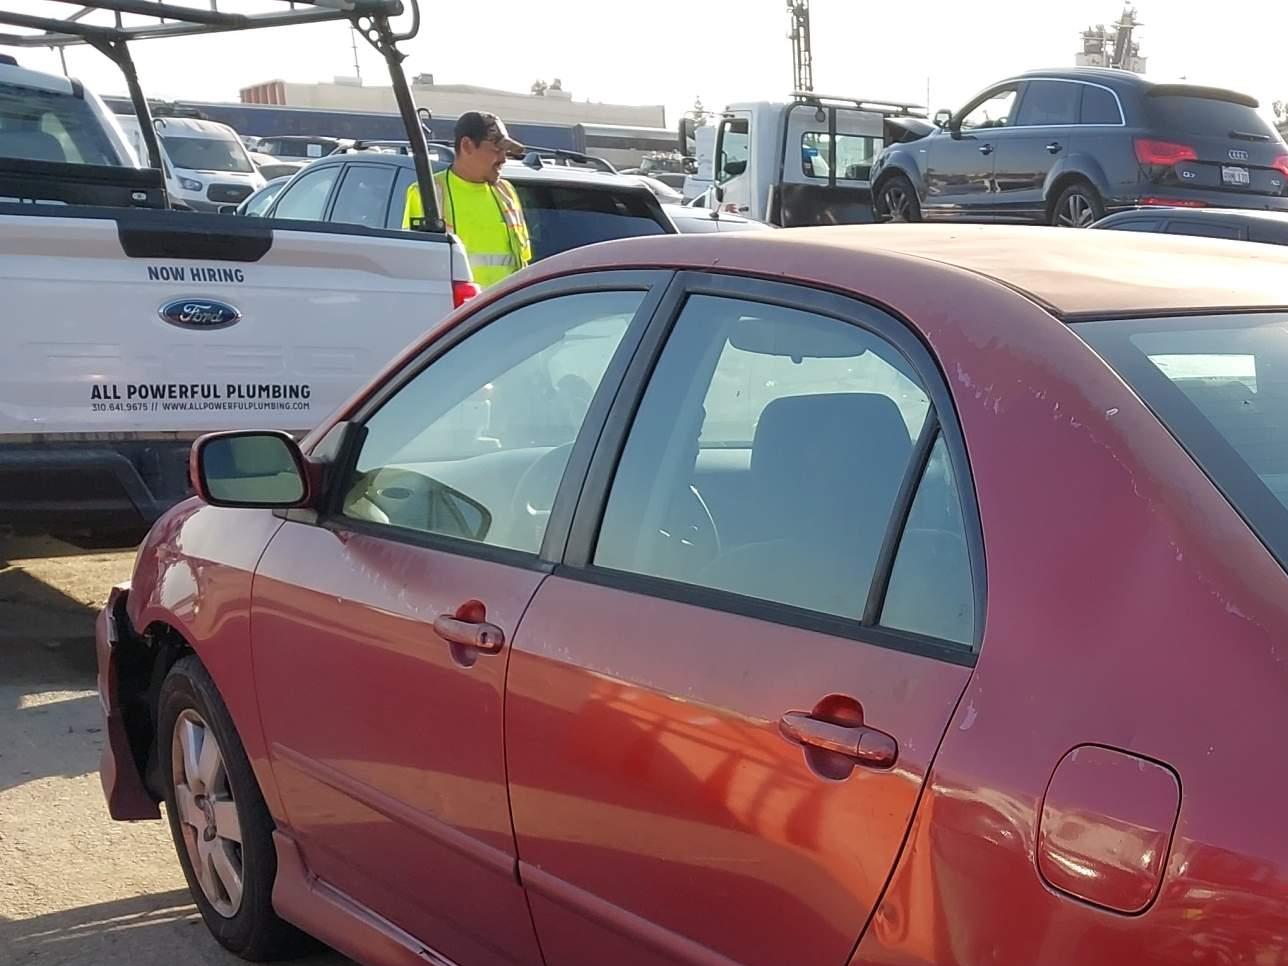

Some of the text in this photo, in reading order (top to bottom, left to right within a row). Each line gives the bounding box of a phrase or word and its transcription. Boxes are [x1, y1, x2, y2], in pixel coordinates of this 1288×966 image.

[147, 266, 245, 283] NOW HIRING
[178, 303, 224, 323] Ford
[90, 384, 311, 400] ALL POWERFUL PLUMBING
[91, 402, 148, 412] 310.641.9675
[162, 402, 310, 411] WWW.ALLPOWERFULPLUMBING.COM
